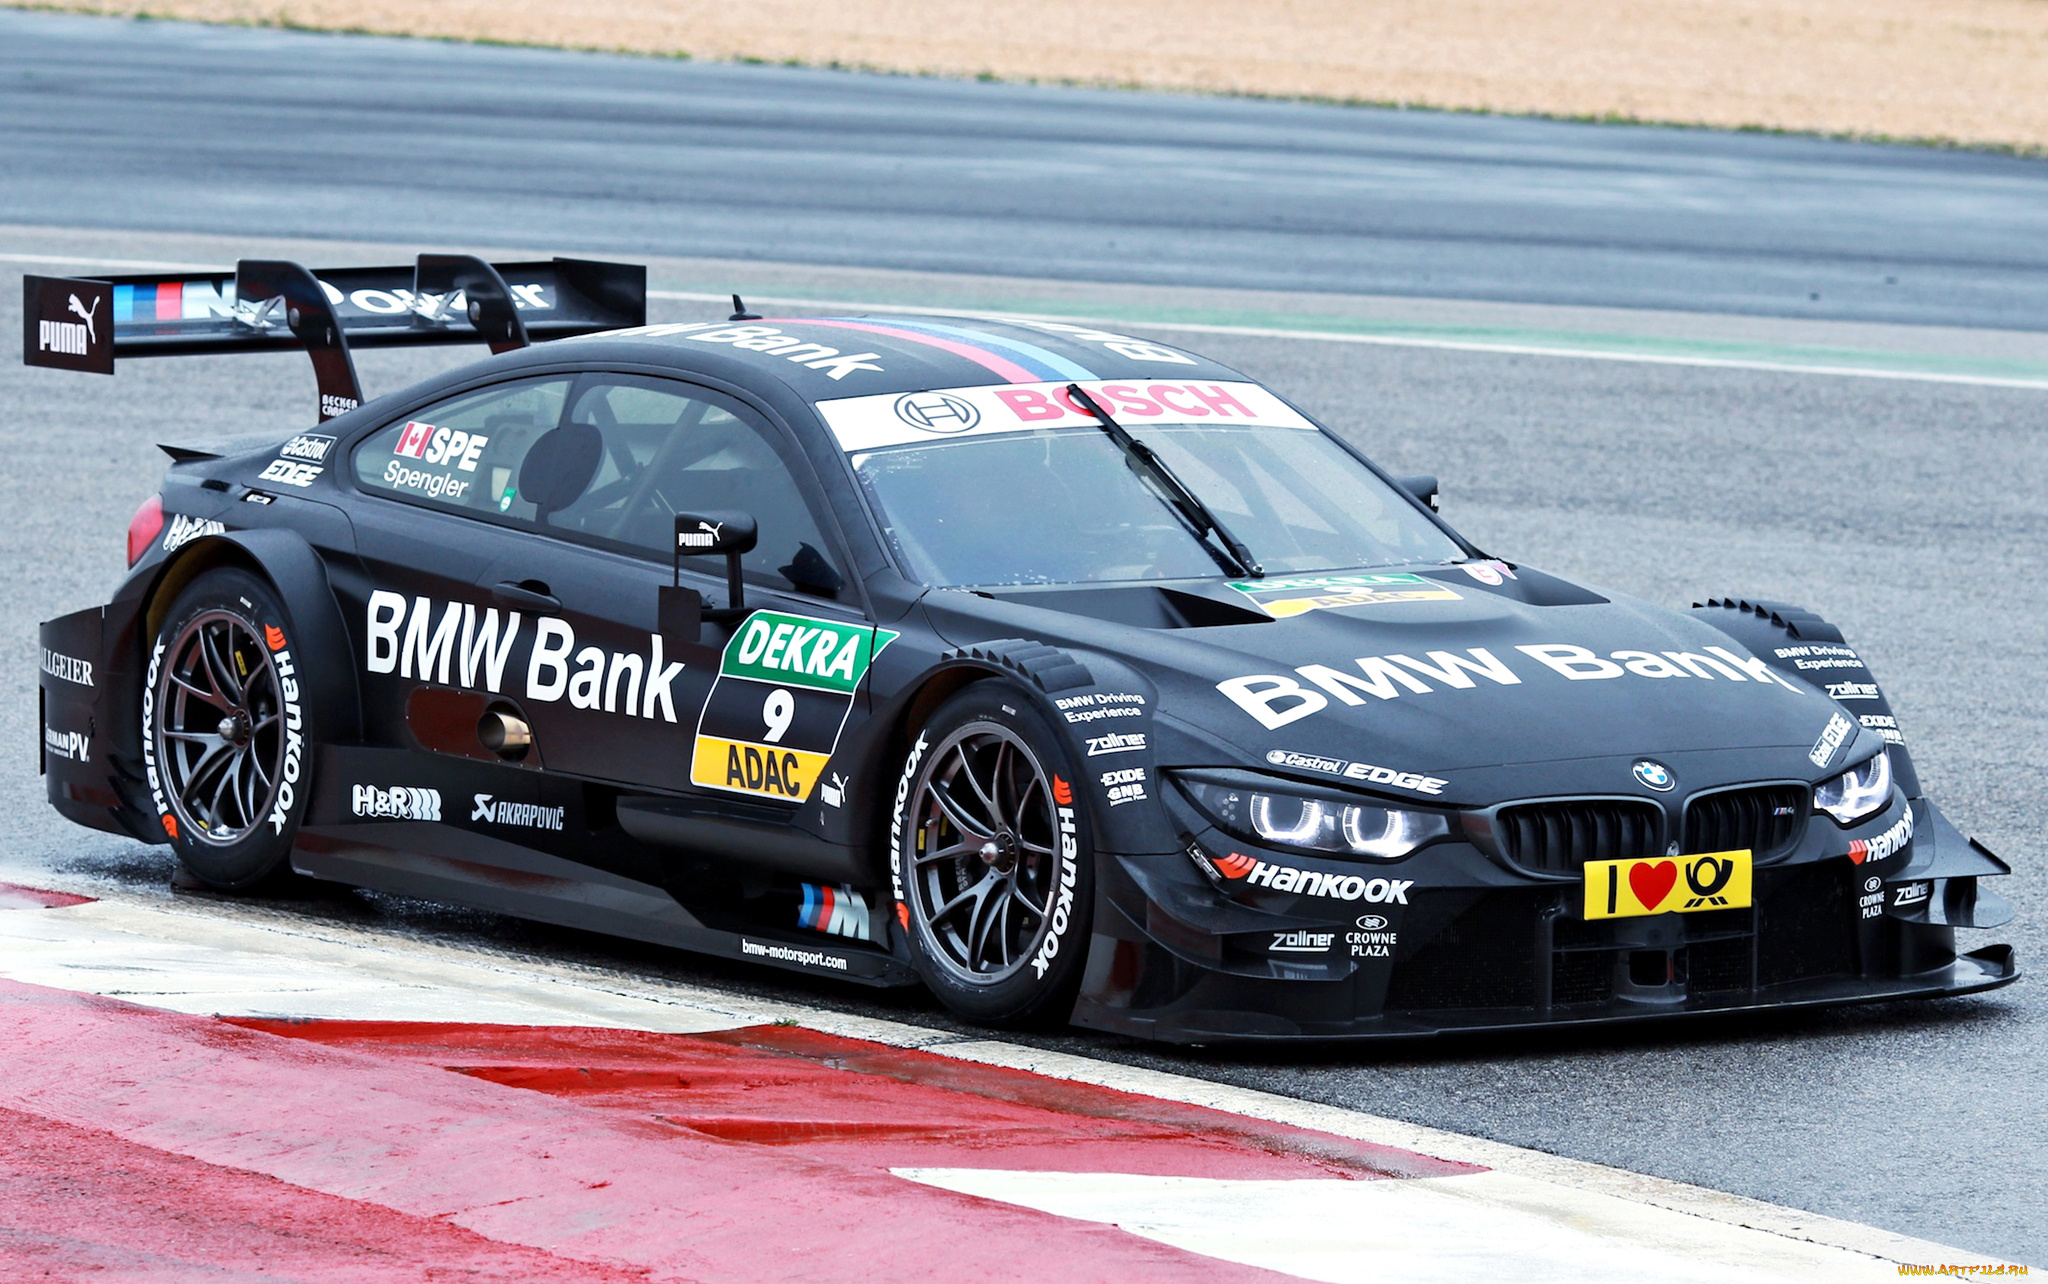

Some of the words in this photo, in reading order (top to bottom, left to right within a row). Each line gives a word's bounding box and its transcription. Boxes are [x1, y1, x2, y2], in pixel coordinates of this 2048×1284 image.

[39, 320, 87, 355] PUMA
[686, 326, 884, 381] Bank
[322, 394, 359, 410] BECKER
[993, 385, 1258, 422] BOSCH
[425, 427, 489, 472] SPE
[258, 459, 324, 487] EDGE
[384, 460, 469, 498] Spengler
[678, 533, 714, 547] PUMA
[40, 647, 95, 687] LLGEIER
[367, 590, 521, 693] BMW
[526, 617, 686, 724] Bank
[738, 619, 861, 681] DEKRA
[1774, 646, 1810, 659] BMW
[1810, 645, 1857, 659] Driving
[1794, 658, 1864, 671] Experience
[1055, 694, 1095, 710] BMW
[1094, 693, 1146, 705] Driving
[1215, 648, 1522, 731] BMW
[1514, 643, 1805, 695] Bank
[143, 633, 169, 816] Hankook
[762, 688, 795, 743] 9
[1063, 707, 1142, 723] Experience
[1821, 712, 1852, 749] EDGE
[1859, 715, 1897, 728] EXIDE
[46, 727, 69, 751] ERMAN
[69, 731, 89, 762] PV
[268, 650, 302, 836] Hankook
[726, 744, 801, 797] ADAC
[1100, 768, 1147, 787] EXIDE
[1285, 753, 1342, 772] Castrol
[1343, 762, 1449, 795] EDGE
[352, 784, 410, 820] H&R
[1107, 783, 1145, 800] GNB
[890, 728, 929, 900] Hankook
[1031, 806, 1077, 980] Hankook
[1247, 861, 1414, 905] Hankook
[1607, 864, 1618, 914] I
[1859, 891, 1885, 907] CROWNE
[1893, 882, 1929, 906] Zollne
[1862, 906, 1883, 919] PLAZA
[742, 938, 847, 970] bmw-motorsport.com
[1345, 932, 1397, 945] CROWNE
[1351, 945, 1389, 957] PLAZA
